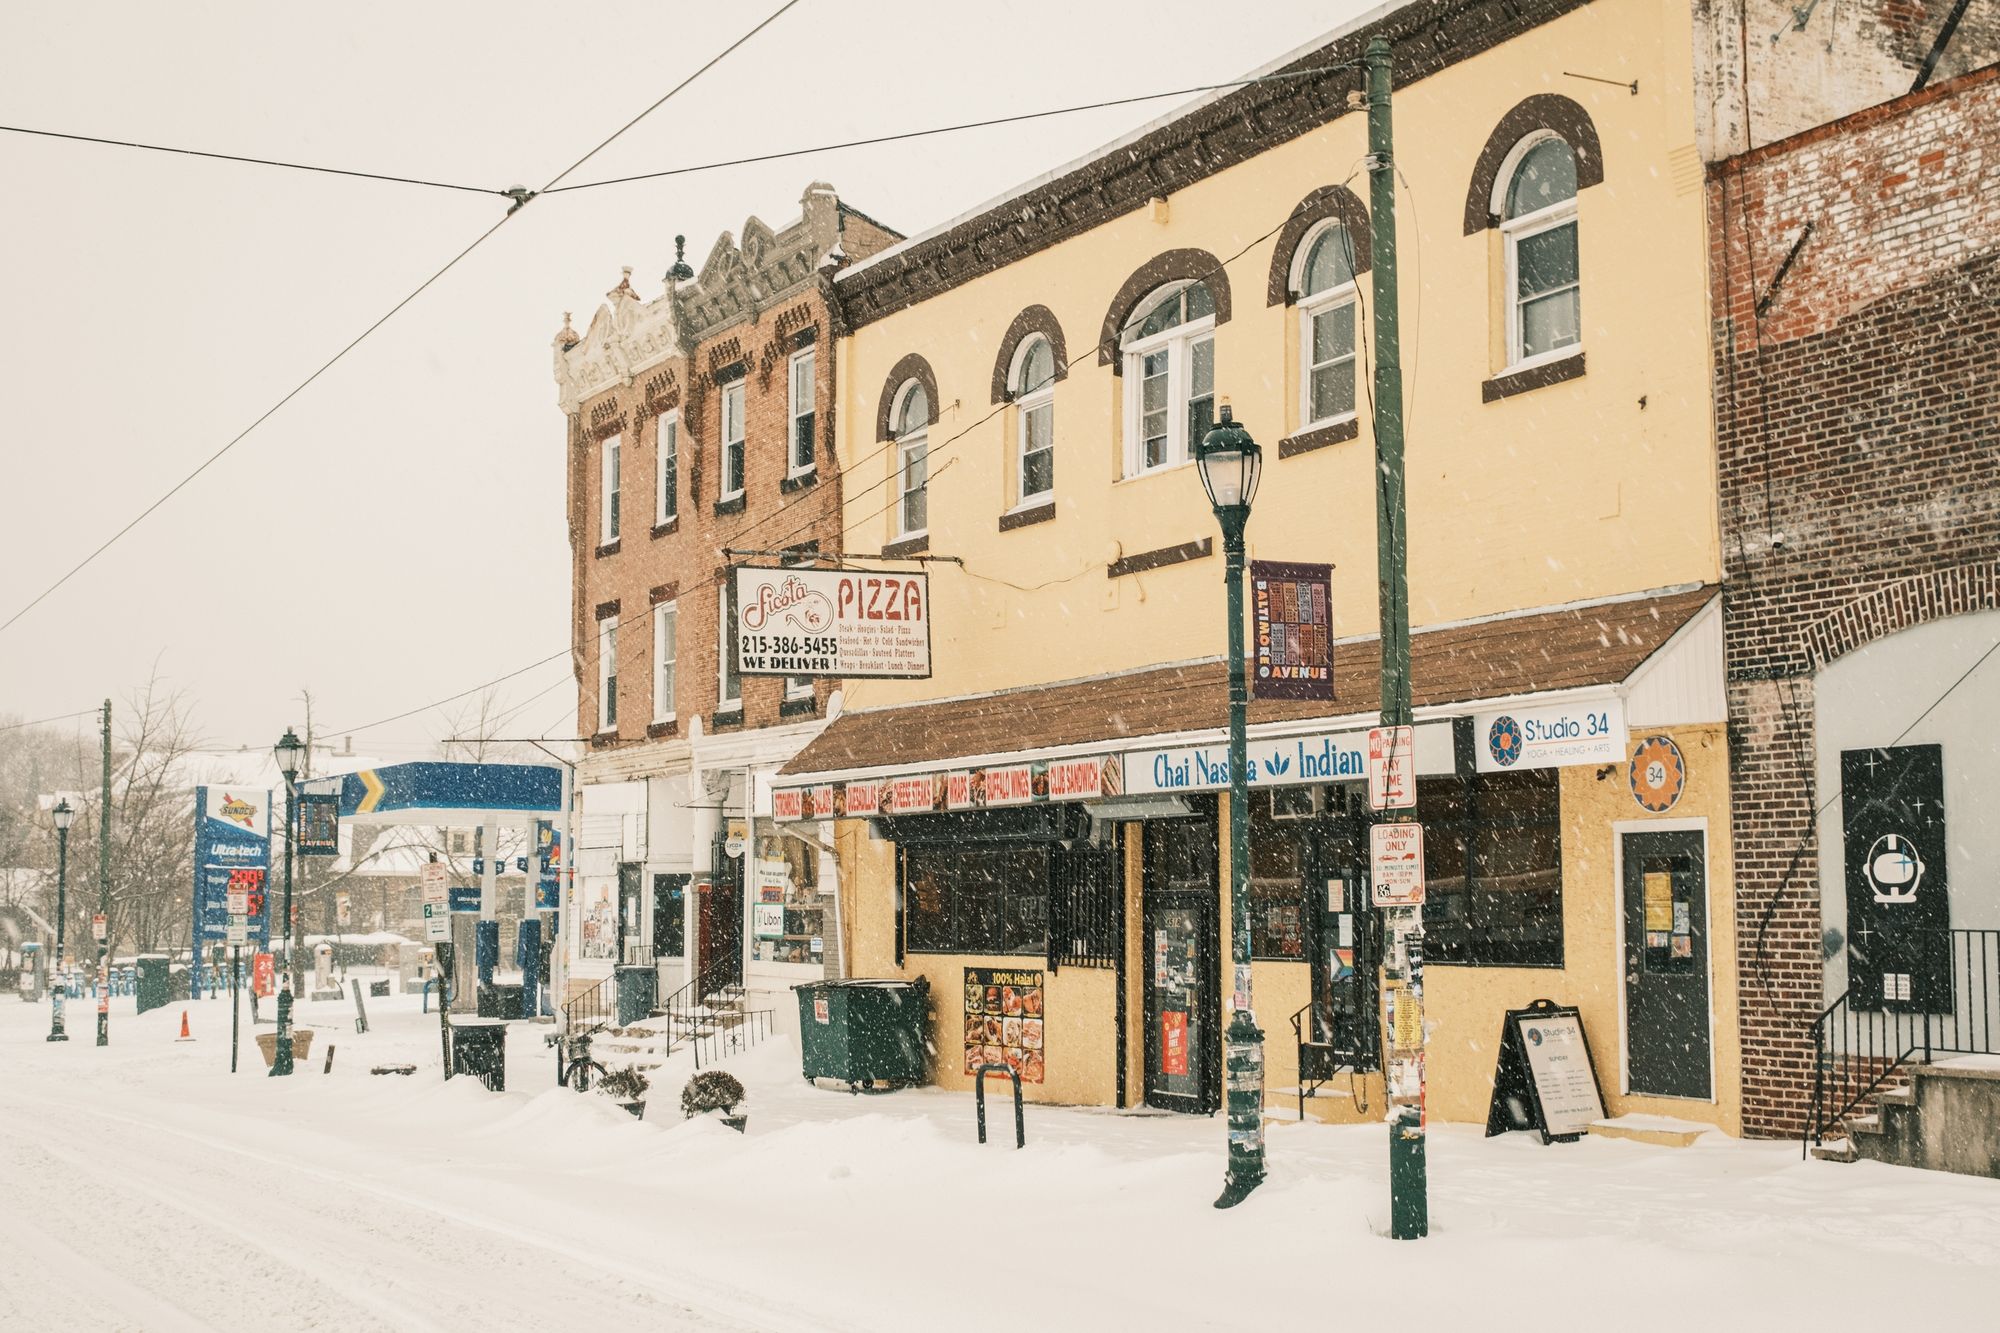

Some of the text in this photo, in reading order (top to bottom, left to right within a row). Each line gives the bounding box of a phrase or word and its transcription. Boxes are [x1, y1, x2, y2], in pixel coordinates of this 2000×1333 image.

[838, 578, 921, 621] PIZZA
[1256, 580, 1271, 665] BALTIMORE
[742, 635, 838, 656] 215-386-5455
[743, 656, 766, 669] WE
[770, 656, 830, 670] DELIVER
[1271, 666, 1328, 679] AVENUE
[1525, 712, 1609, 741] Studio 34
[1370, 736, 1410, 753] NO PAING
[1527, 743, 1610, 759] YOGA HEALING ARTS
[1154, 739, 1364, 787] Chai Nasa Indian
[1066, 762, 1098, 794] SANDWICH
[1381, 774, 1402, 787] TME
[1649, 767, 1664, 783] 34
[950, 775, 967, 803] WRAPS
[223, 806, 255, 816] SUNOCO
[1378, 828, 1415, 840] LOADING
[1385, 841, 1407, 852] ONLY
[425, 905, 431, 917] 2
[1019, 895, 1047, 920] OPE
[992, 972, 1034, 986] 100% Halal
